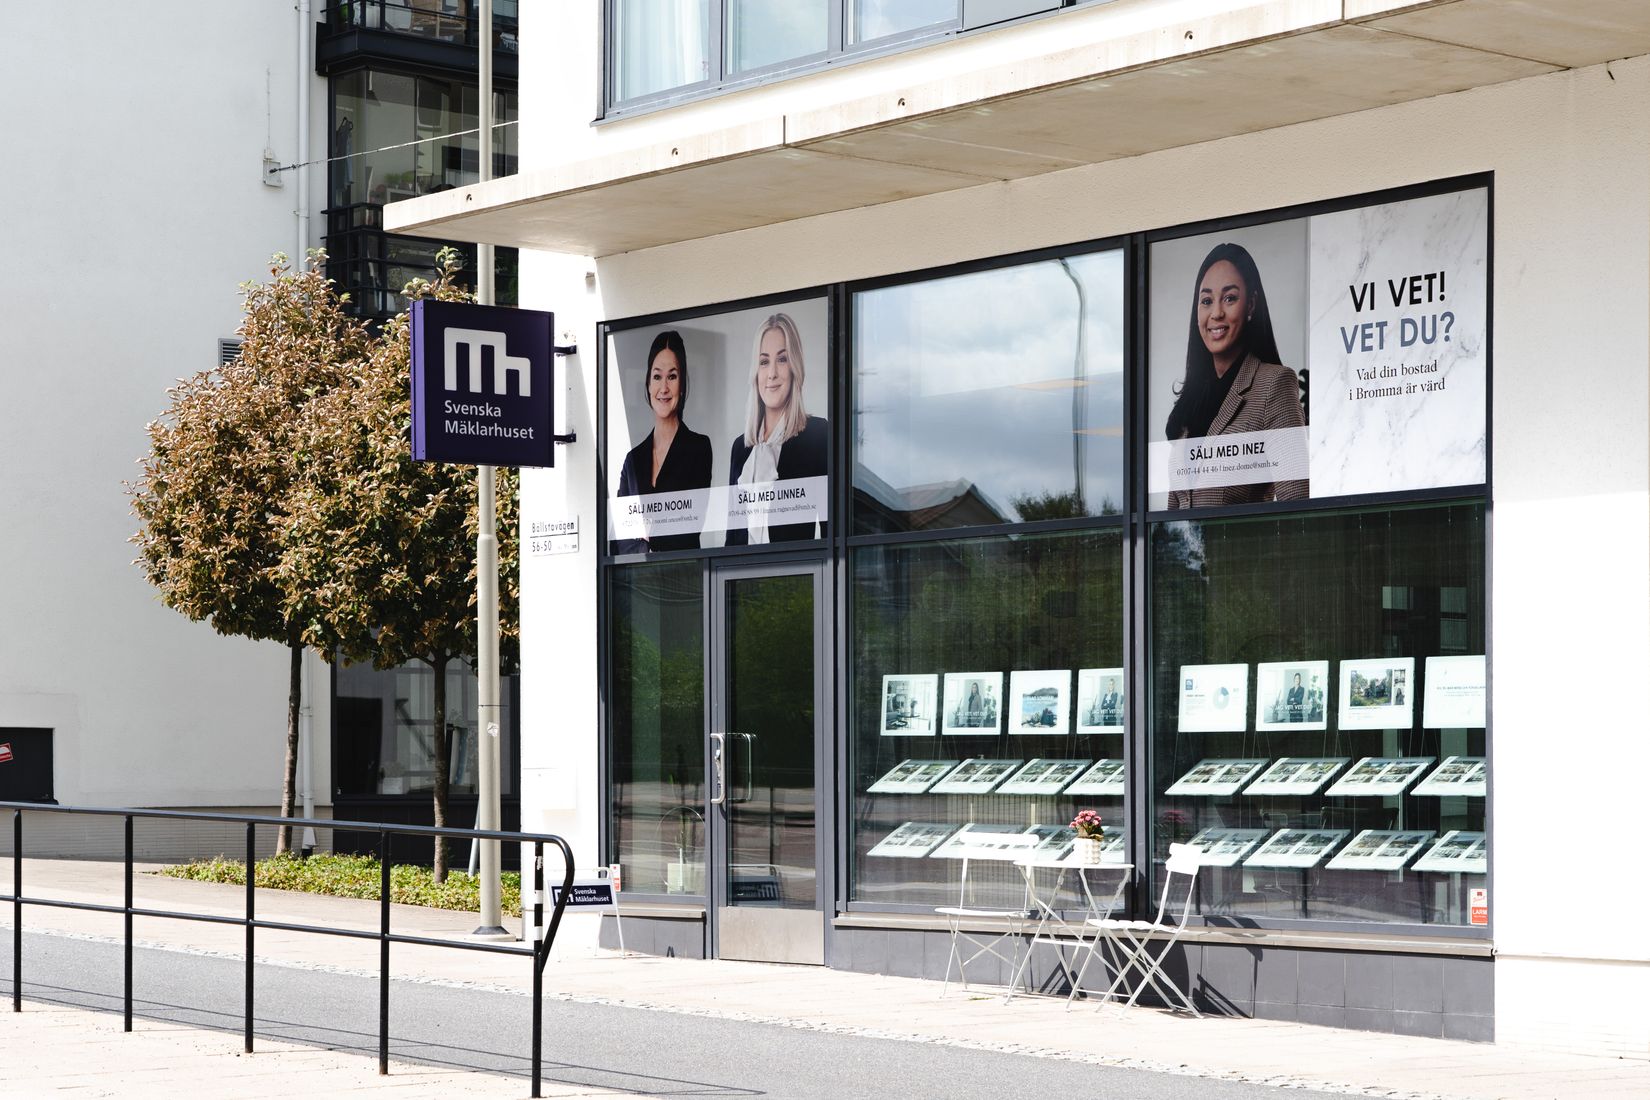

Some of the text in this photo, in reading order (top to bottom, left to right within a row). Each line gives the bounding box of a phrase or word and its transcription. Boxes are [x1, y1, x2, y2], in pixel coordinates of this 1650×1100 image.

[1349, 271, 1445, 312] VI VET!
[1340, 311, 1455, 354] VET DU?
[1356, 359, 1438, 380] Vad din bostad
[1349, 377, 1446, 400] i Bromma är värd
[444, 400, 502, 417] Svenska
[445, 420, 534, 439] Mäklarhuset
[1190, 442, 1265, 460] SÄLJ MED INEZ
[738, 488, 806, 504] SÄLJ MED LINNEA
[628, 499, 692, 515] SÄLJ MED NOOMI
[575, 895, 610, 903] Mäklarhuset
